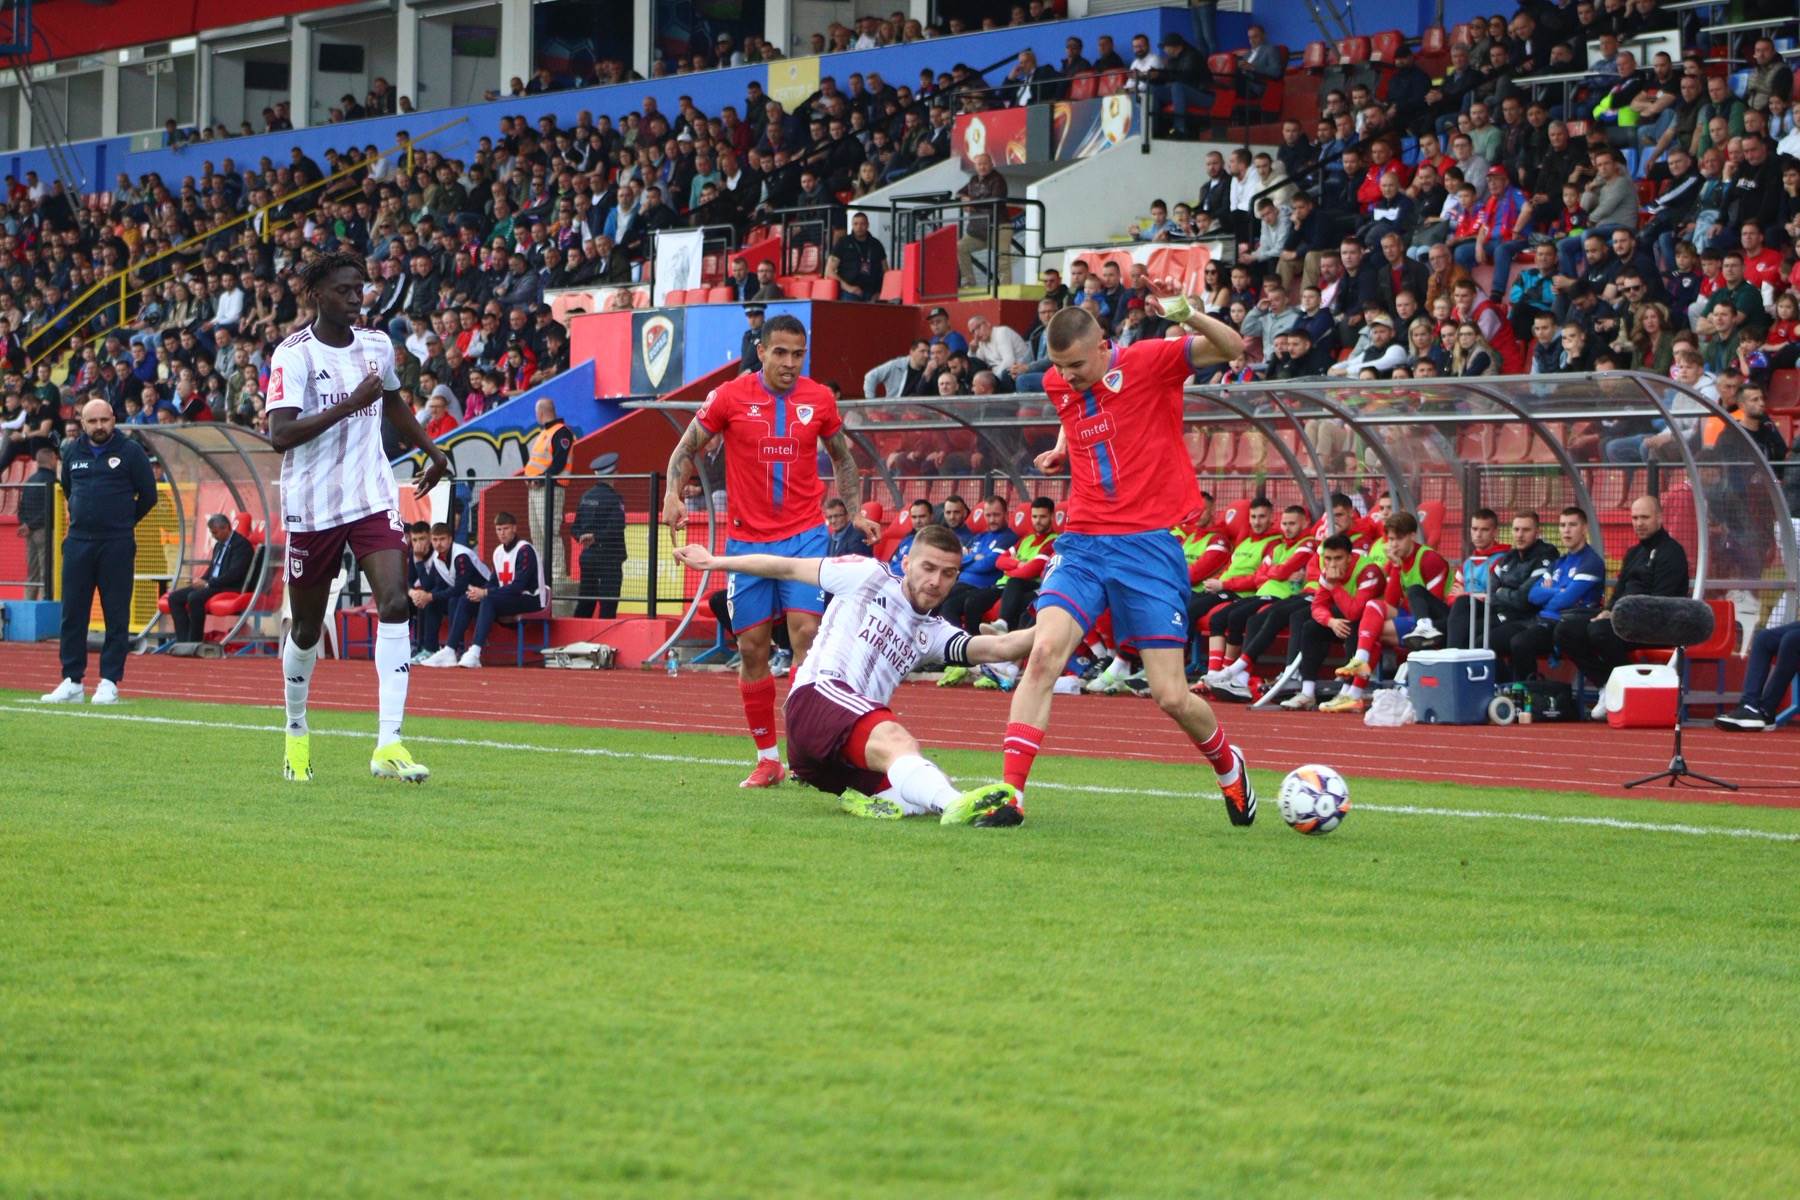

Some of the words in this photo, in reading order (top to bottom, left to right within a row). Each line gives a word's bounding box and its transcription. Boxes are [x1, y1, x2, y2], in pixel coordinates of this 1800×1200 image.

[1080, 418, 1110, 440] m:tel
[763, 444, 793, 455] m:tel
[858, 628, 910, 677] AIRLINES
[869, 614, 917, 665] TURKISH
